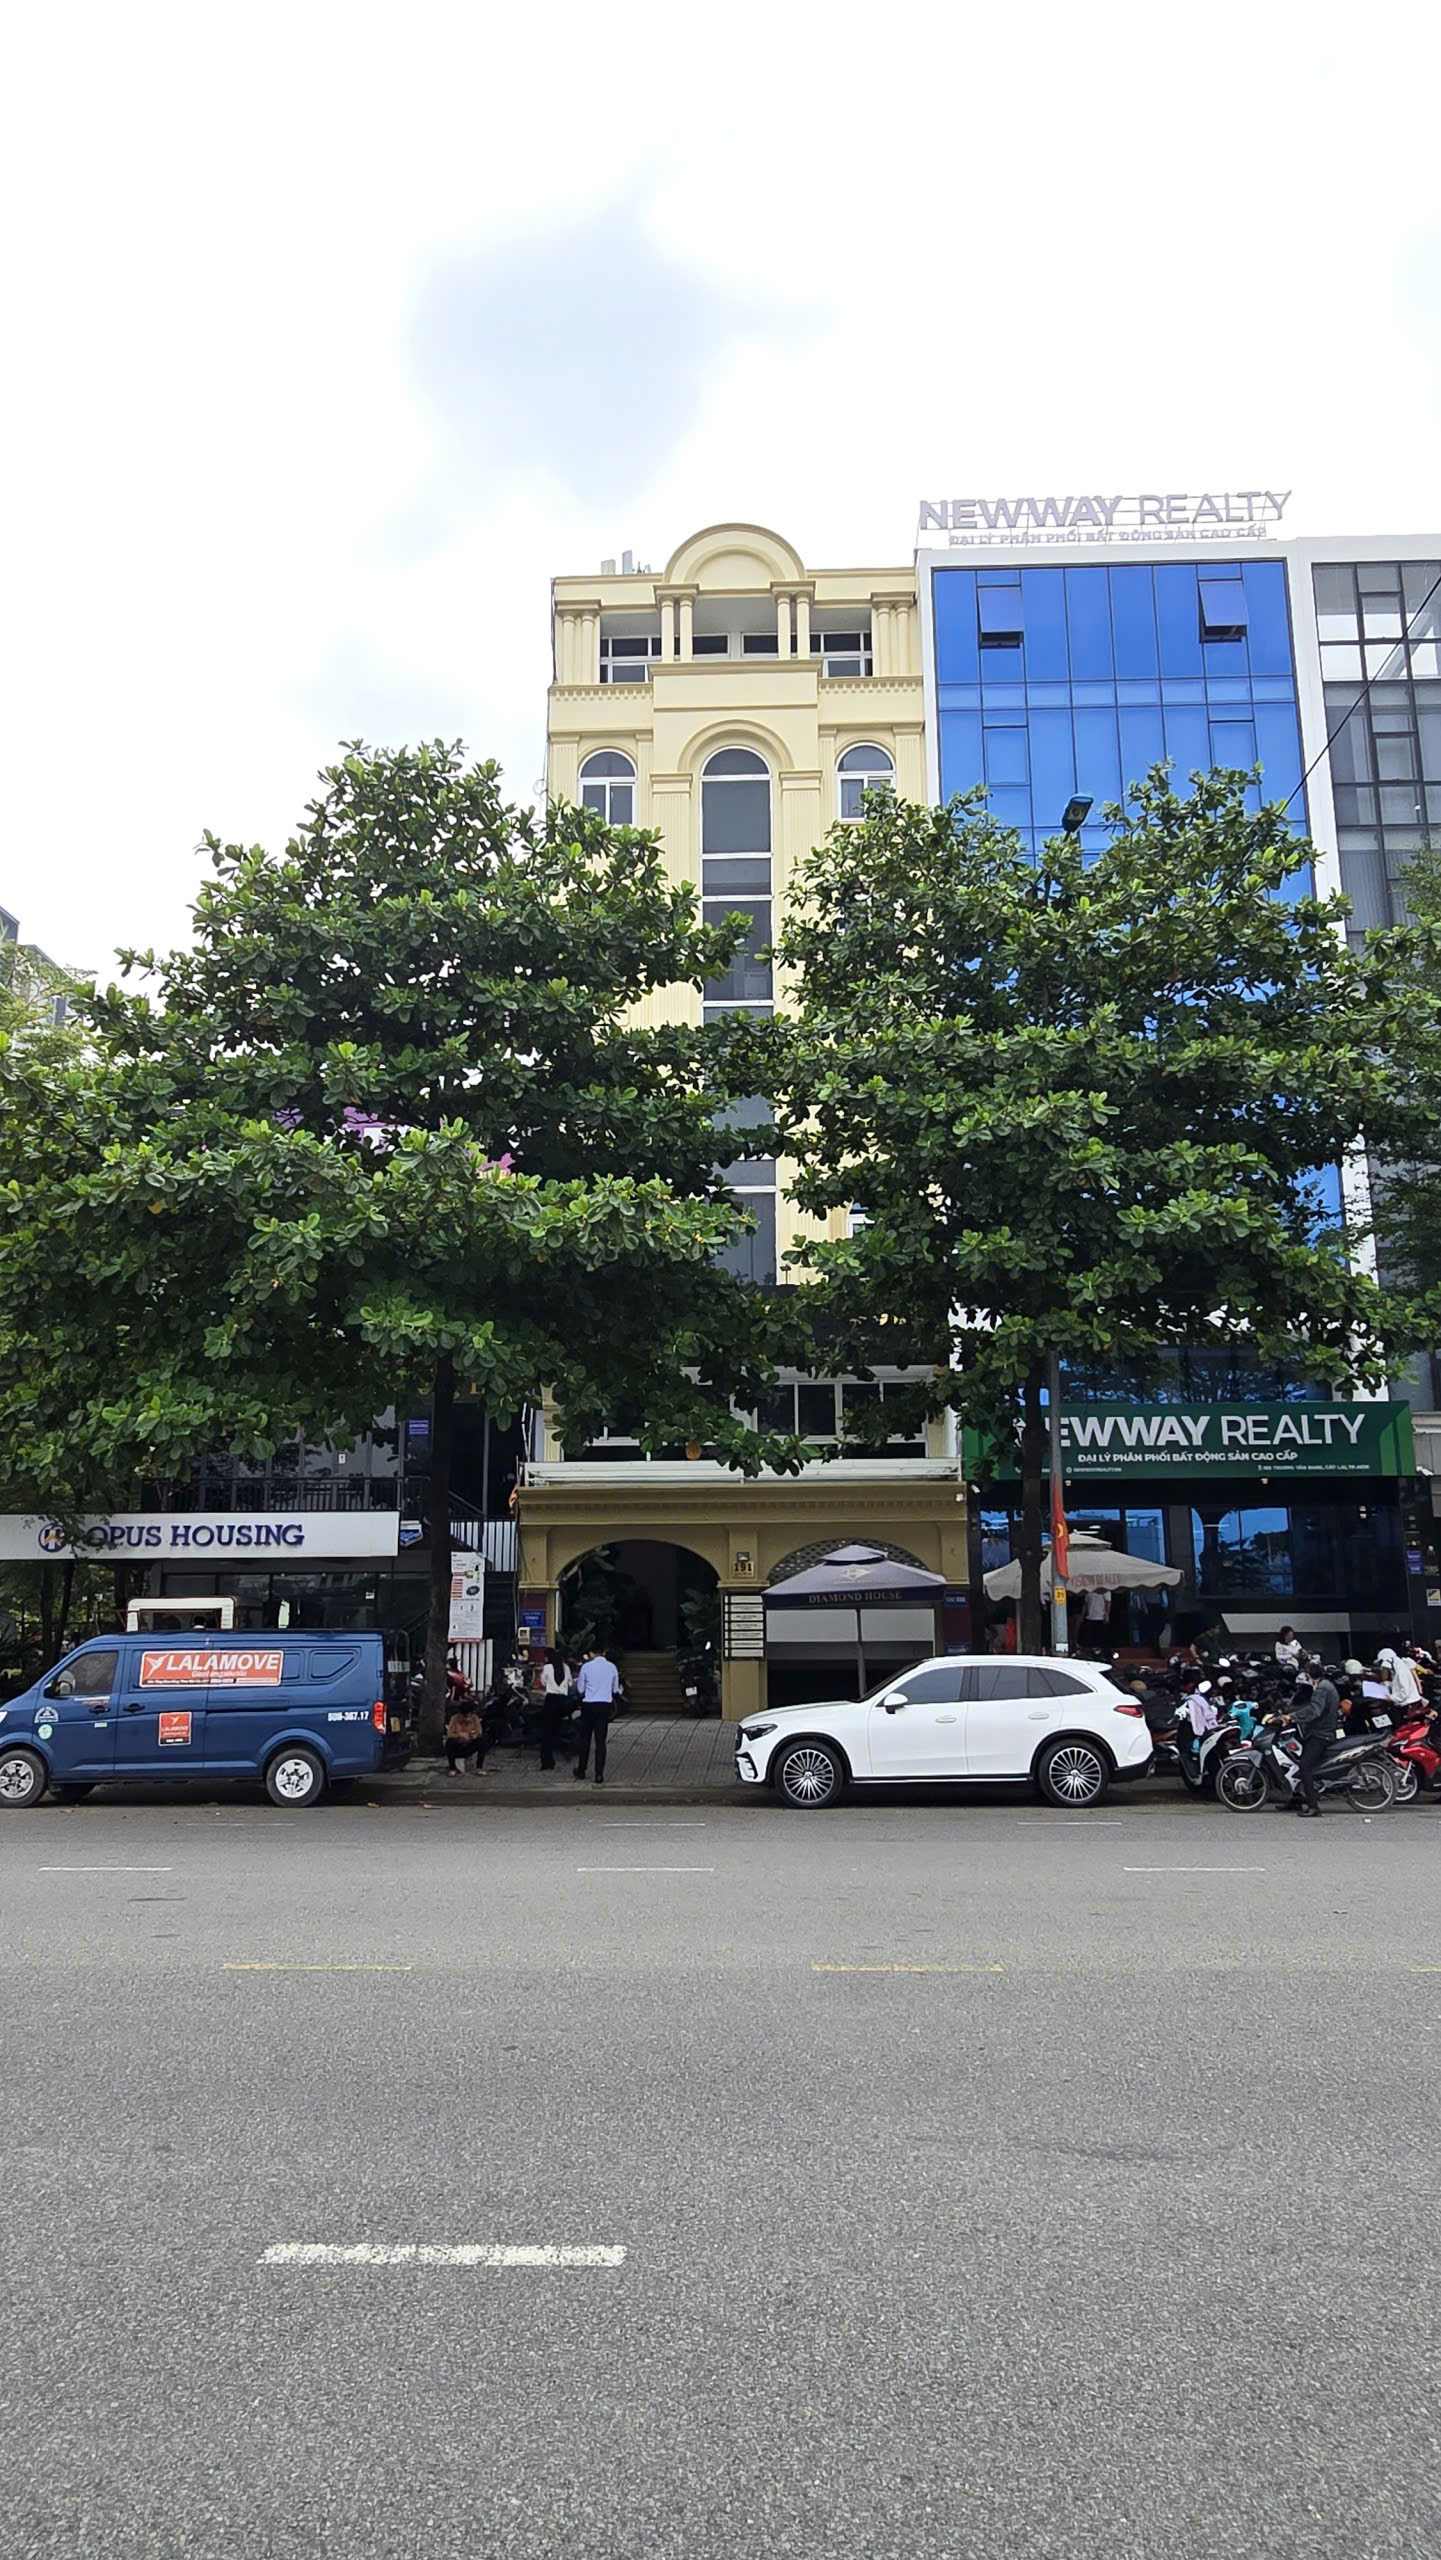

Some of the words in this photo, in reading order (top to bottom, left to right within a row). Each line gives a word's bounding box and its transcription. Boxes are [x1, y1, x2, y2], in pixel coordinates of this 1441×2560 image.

[919, 495, 1123, 530] NEWWAY
[1139, 489, 1292, 525] REALTY
[1044, 1416, 1210, 1448] EWWAY
[1220, 1413, 1366, 1446] REALTY
[1077, 1453, 1097, 1465] ĐẠI
[1099, 1451, 1111, 1463] LÝ
[1113, 1452, 1143, 1463] PHÂN
[1145, 1450, 1171, 1463] PHỐI
[1173, 1450, 1193, 1462] BẤT
[1195, 1451, 1227, 1463] ĐỘNG
[1228, 1450, 1250, 1462] SẢN
[1251, 1452, 1274, 1461] CAO
[1276, 1449, 1298, 1461] CẤP
[83, 1525, 162, 1547] OPUS
[170, 1524, 305, 1547] HOUSING
[734, 1562, 753, 1572] 191
[808, 1592, 862, 1604] DIAMOND
[866, 1590, 903, 1601] HOUSE
[165, 1653, 282, 1672] LALAMOVE
